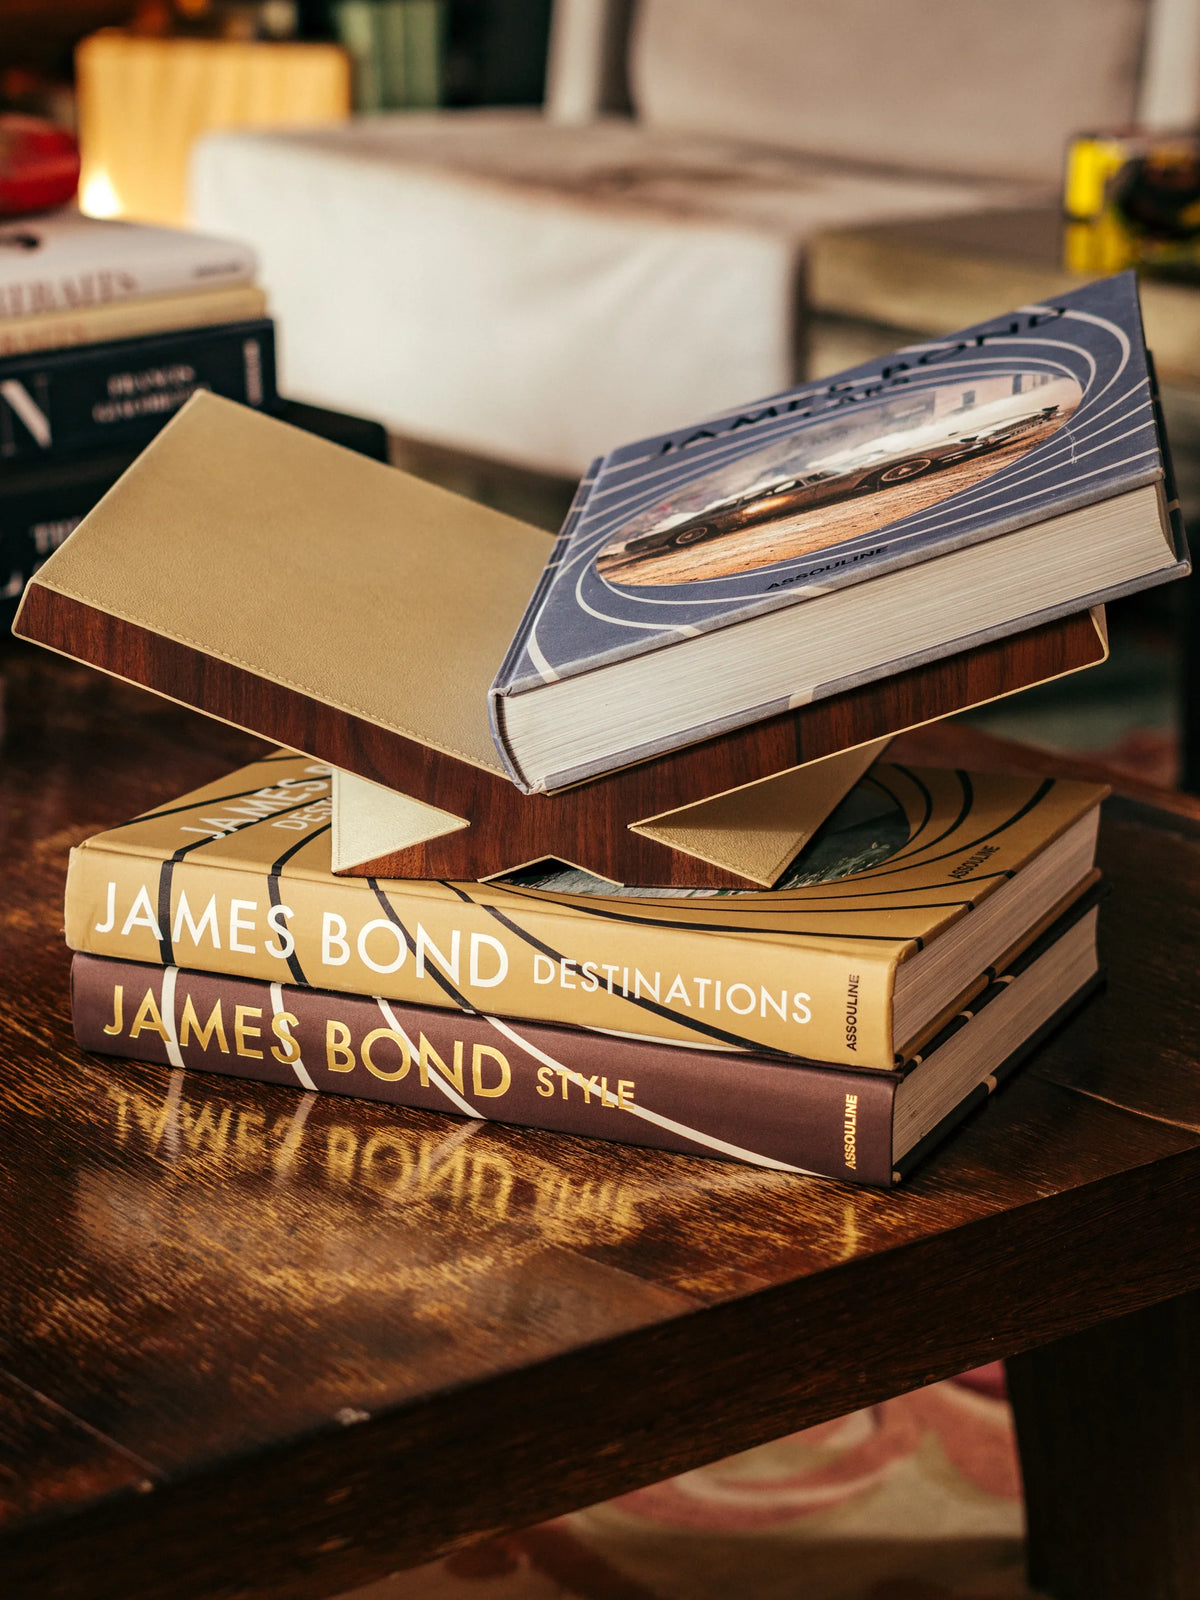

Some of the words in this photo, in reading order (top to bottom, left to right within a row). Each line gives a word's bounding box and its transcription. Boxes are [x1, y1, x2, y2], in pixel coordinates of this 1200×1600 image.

[882, 307, 1066, 380] BOND
[766, 545, 889, 591] ASSOULINE
[180, 777, 329, 840] JAMES
[947, 845, 1000, 879] ASSOULINE
[95, 882, 295, 959] JAMES
[321, 912, 509, 988] BOND
[532, 954, 812, 1025] DESTINATIONS
[103, 984, 301, 1065] JAMES
[326, 1019, 512, 1098] BOND
[536, 1066, 636, 1111] STYLE
[846, 974, 860, 1051] ASSOULINE
[844, 1094, 858, 1170] ASSOULINE
